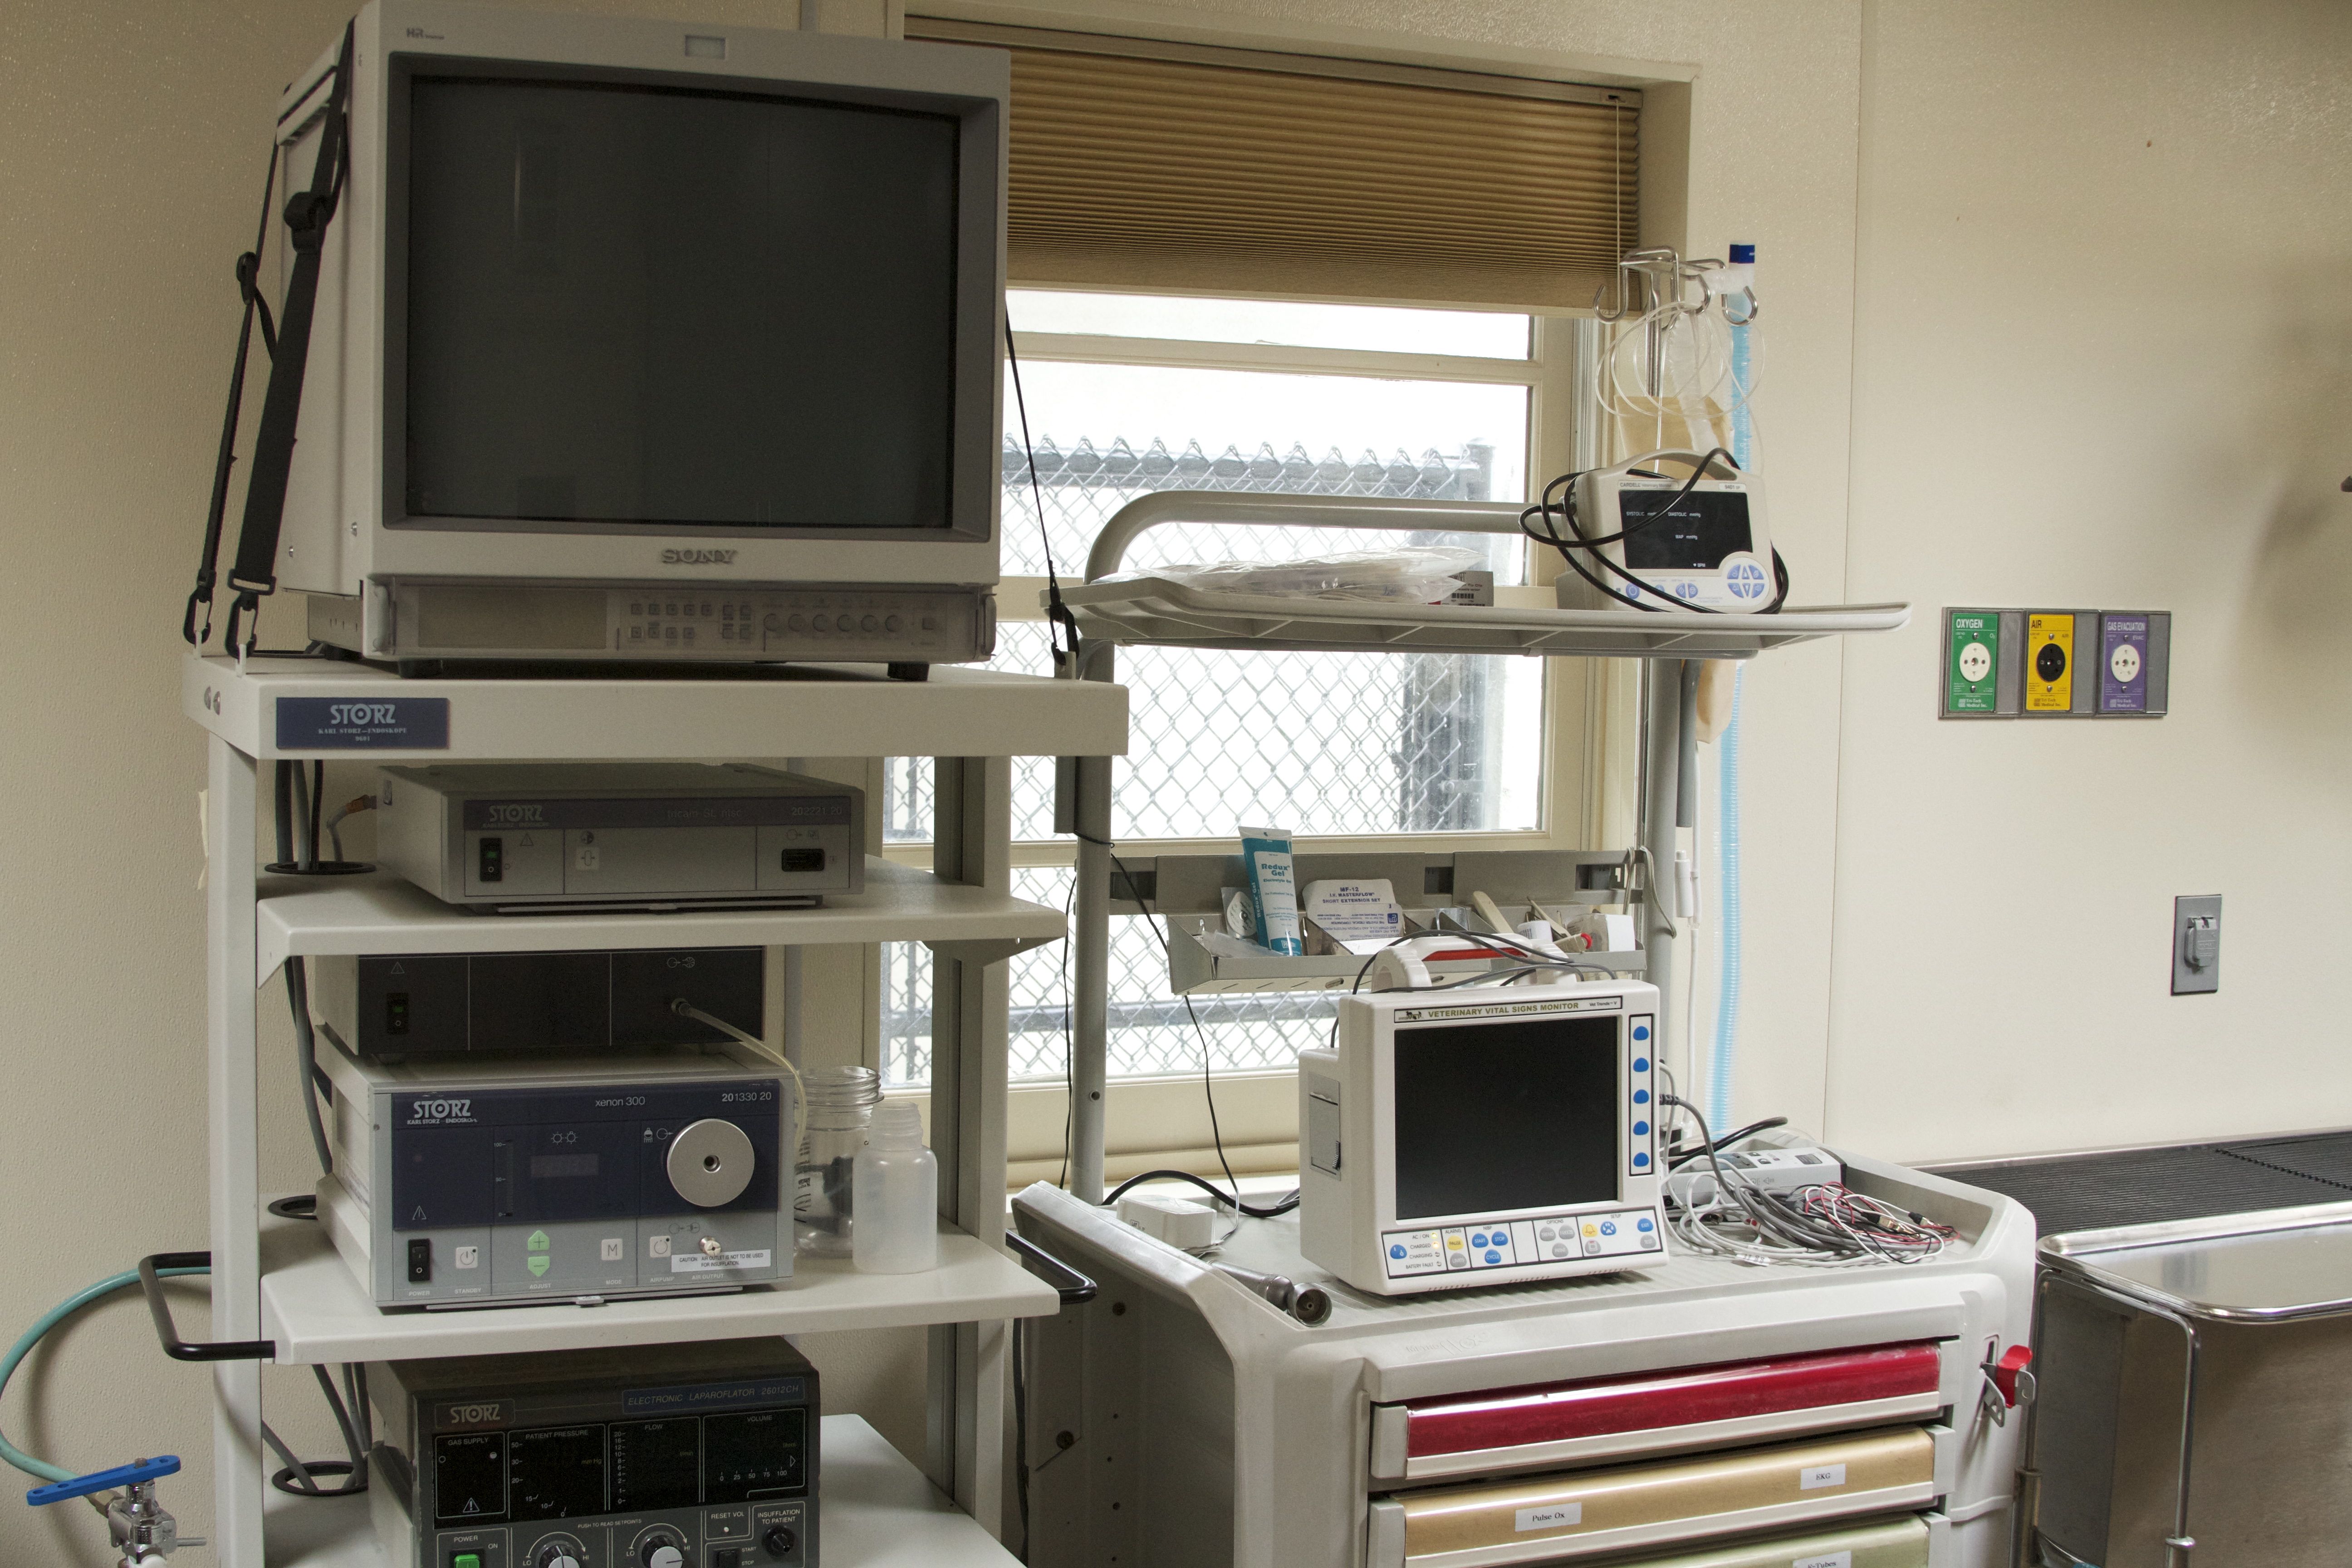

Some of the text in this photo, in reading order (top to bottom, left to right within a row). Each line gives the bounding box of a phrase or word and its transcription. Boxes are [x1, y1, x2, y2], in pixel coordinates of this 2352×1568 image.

[662, 549, 736, 564] SONY
[1956, 618, 1983, 628] OXYGEN
[2031, 619, 2042, 628] AIR
[2107, 622, 2146, 631] GAS EVACUATION
[330, 704, 396, 725] STORZ
[490, 805, 544, 822] STORZ
[791, 806, 842, 816] 202221 20
[1428, 1009, 1482, 1018] VETERINARY
[1540, 1003, 1578, 1011] MONITOR
[595, 1096, 646, 1107] xenon 300
[721, 1091, 772, 1102] 201330 20
[413, 1099, 471, 1118] STORZ
[608, 1244, 617, 1256] M
[628, 1385, 799, 1406] ELECTRONIC LAPAROFLATOR 26012CH
[450, 1404, 500, 1423] STORZ
[757, 1509, 800, 1518] INSUFFLATION
